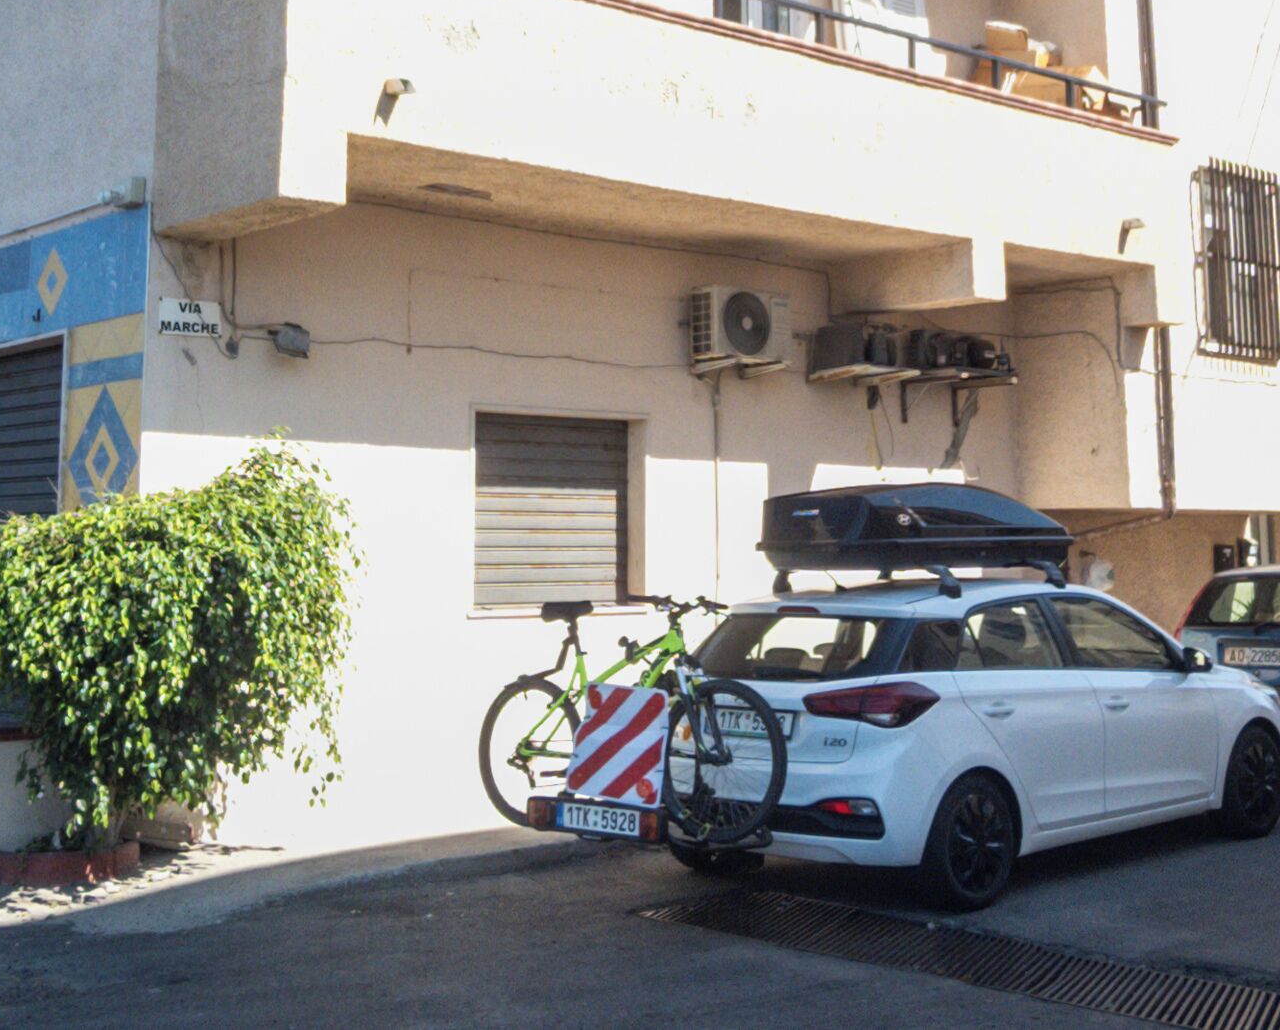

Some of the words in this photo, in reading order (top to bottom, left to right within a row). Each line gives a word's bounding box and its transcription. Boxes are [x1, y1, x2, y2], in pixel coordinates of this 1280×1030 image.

[179, 301, 202, 314] VIA
[160, 320, 219, 334] MARCHE
[823, 736, 847, 746] i20
[601, 809, 636, 832] 5928
